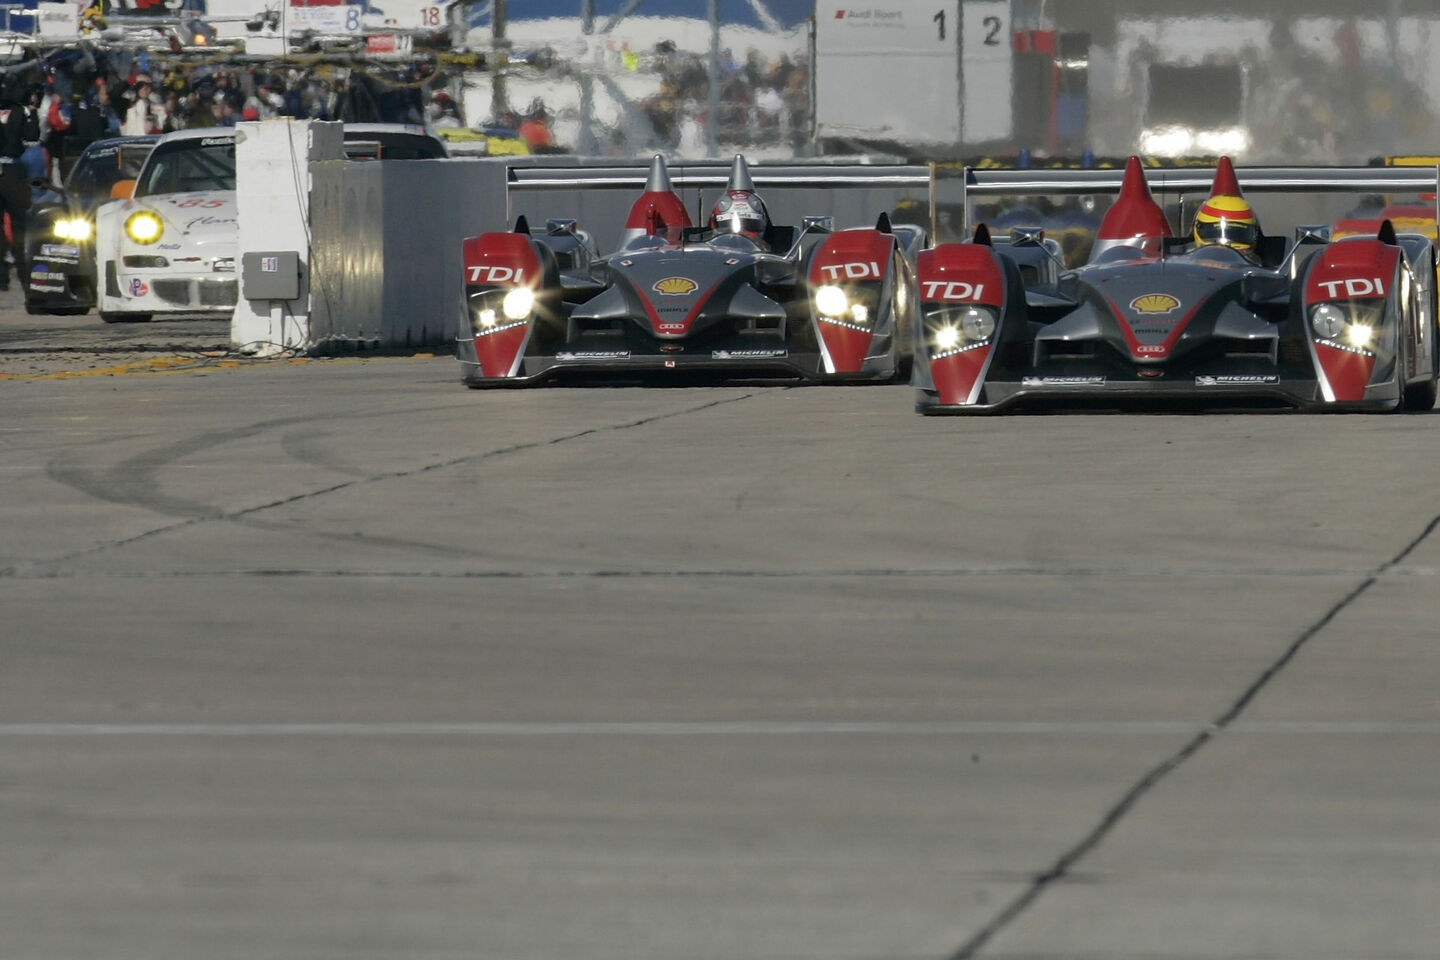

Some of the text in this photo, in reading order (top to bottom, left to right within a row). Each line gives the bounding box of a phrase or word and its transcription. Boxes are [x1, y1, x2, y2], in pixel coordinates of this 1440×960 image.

[346, 8, 359, 30] 8
[421, 7, 441, 26] 18
[933, 9, 946, 41] 1
[983, 17, 1001, 46] 2
[467, 266, 524, 283] TDI
[821, 262, 881, 280] TDI
[922, 281, 985, 301] TDI
[1318, 278, 1385, 298] TDI
